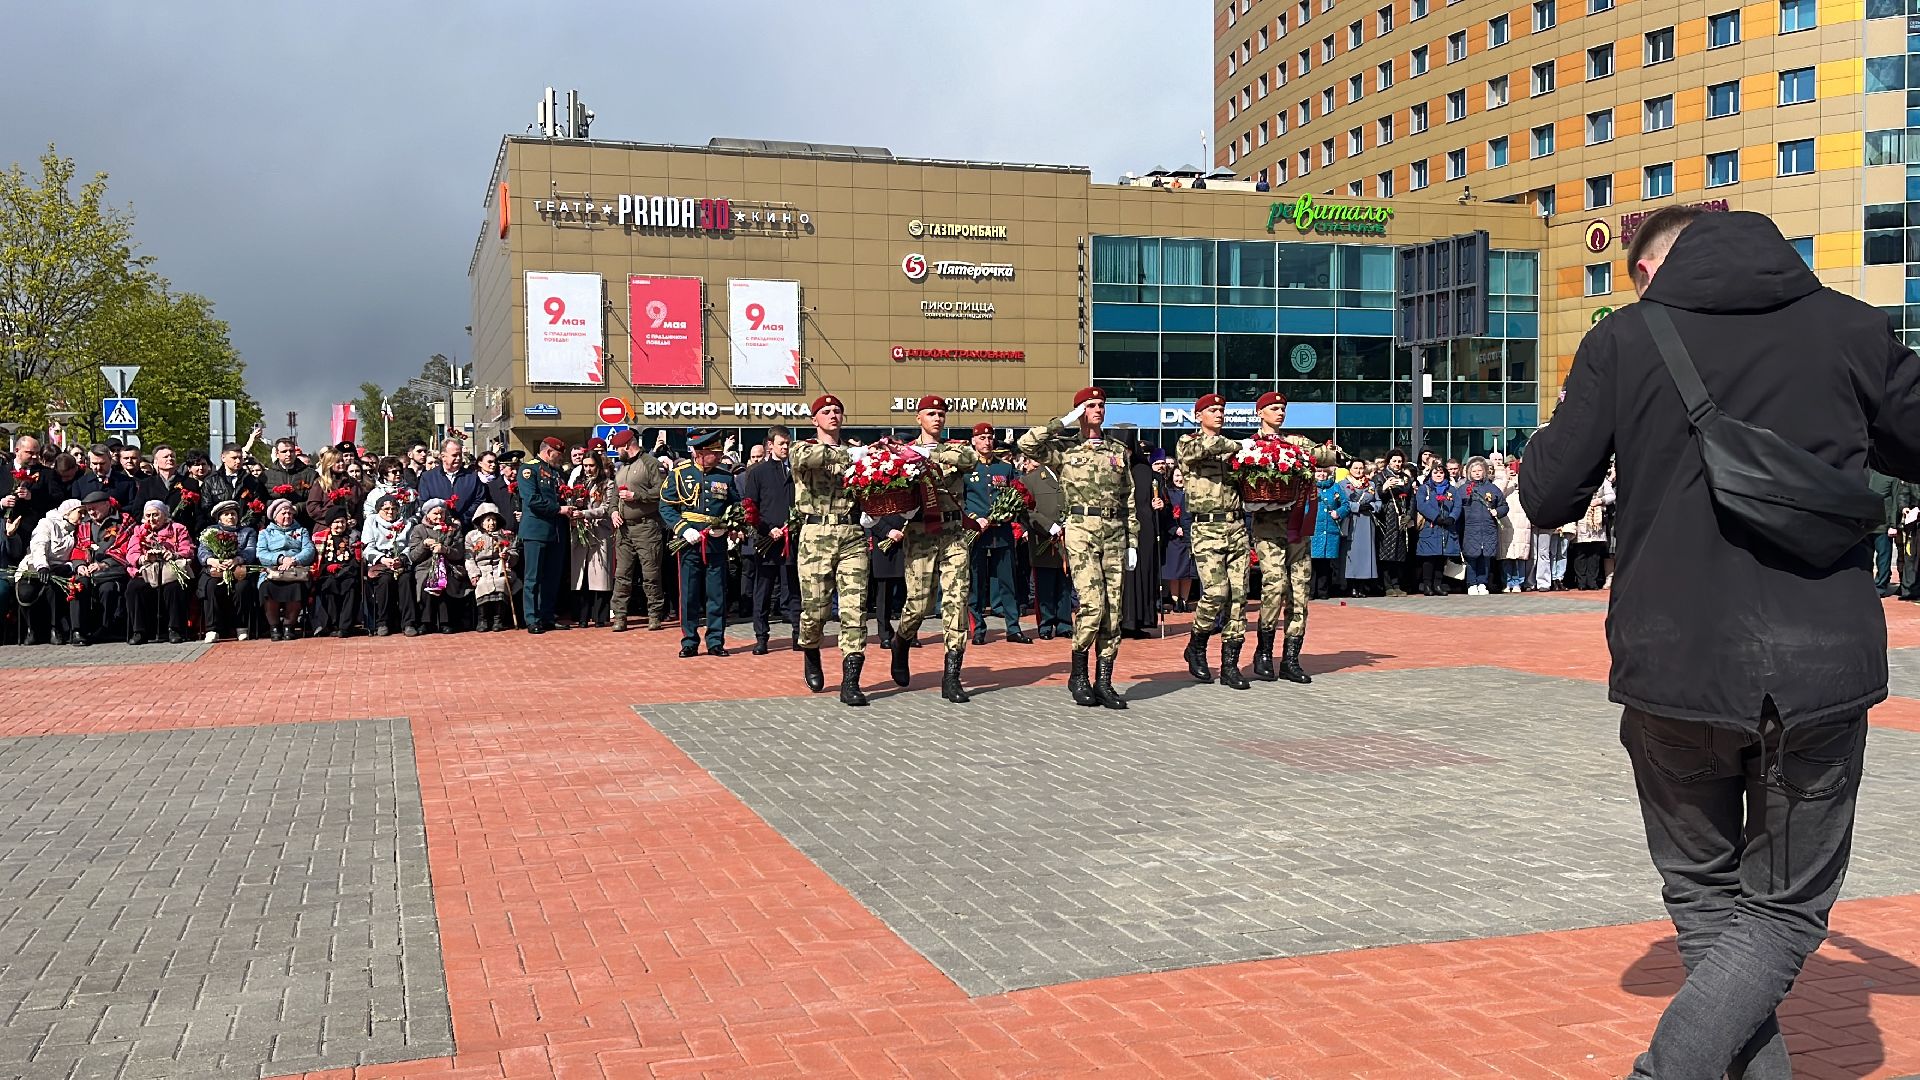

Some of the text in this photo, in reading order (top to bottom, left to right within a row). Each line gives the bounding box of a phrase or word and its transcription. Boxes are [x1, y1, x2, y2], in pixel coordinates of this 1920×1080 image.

[534, 194, 810, 230] ТЕАТР PRADA 3D КИНО
[929, 223, 1007, 237] ГАЗПРОМБАНК
[932, 260, 1014, 278] Пятерочка
[543, 296, 566, 325] 9
[645, 300, 668, 329] 9
[920, 300, 995, 313] ПИКО ПИЦЦА
[745, 303, 766, 331] 9
[907, 348, 1025, 359] АЛЬФАСТРАХОВАНИЕ
[643, 401, 718, 416] ВКУСНО
[751, 402, 812, 416] ТОЧКА
[981, 397, 1027, 411] ЛАУНЖ
[1160, 408, 1201, 424] DN
